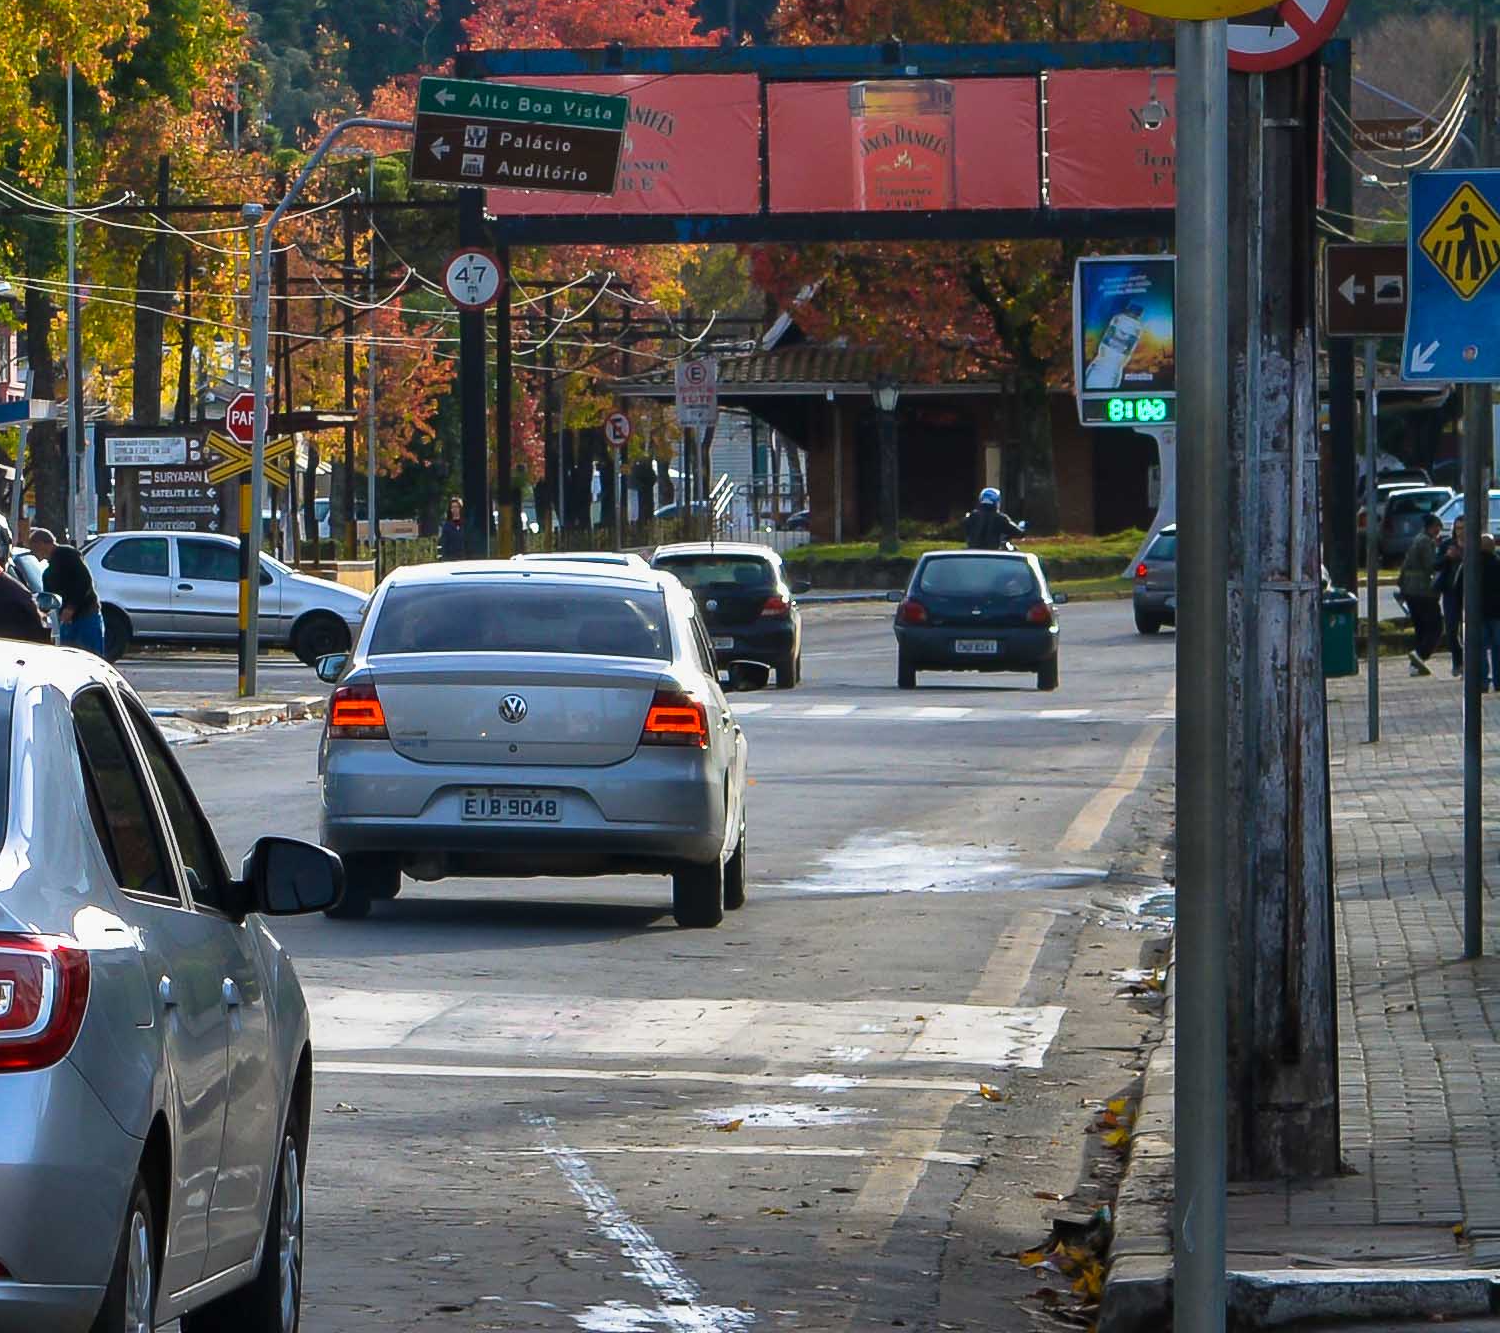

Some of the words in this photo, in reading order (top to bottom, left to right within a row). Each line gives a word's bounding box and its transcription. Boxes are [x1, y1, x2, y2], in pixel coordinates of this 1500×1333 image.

[468, 92, 510, 111] Alto
[517, 96, 553, 116] Boa
[562, 100, 613, 121] Vista
[499, 133, 572, 154] Palácio
[860, 131, 892, 158] JACK
[894, 123, 948, 156] DANIEL'S
[496, 160, 589, 183] Auditório
[153, 471, 202, 483] SURYAPAN
